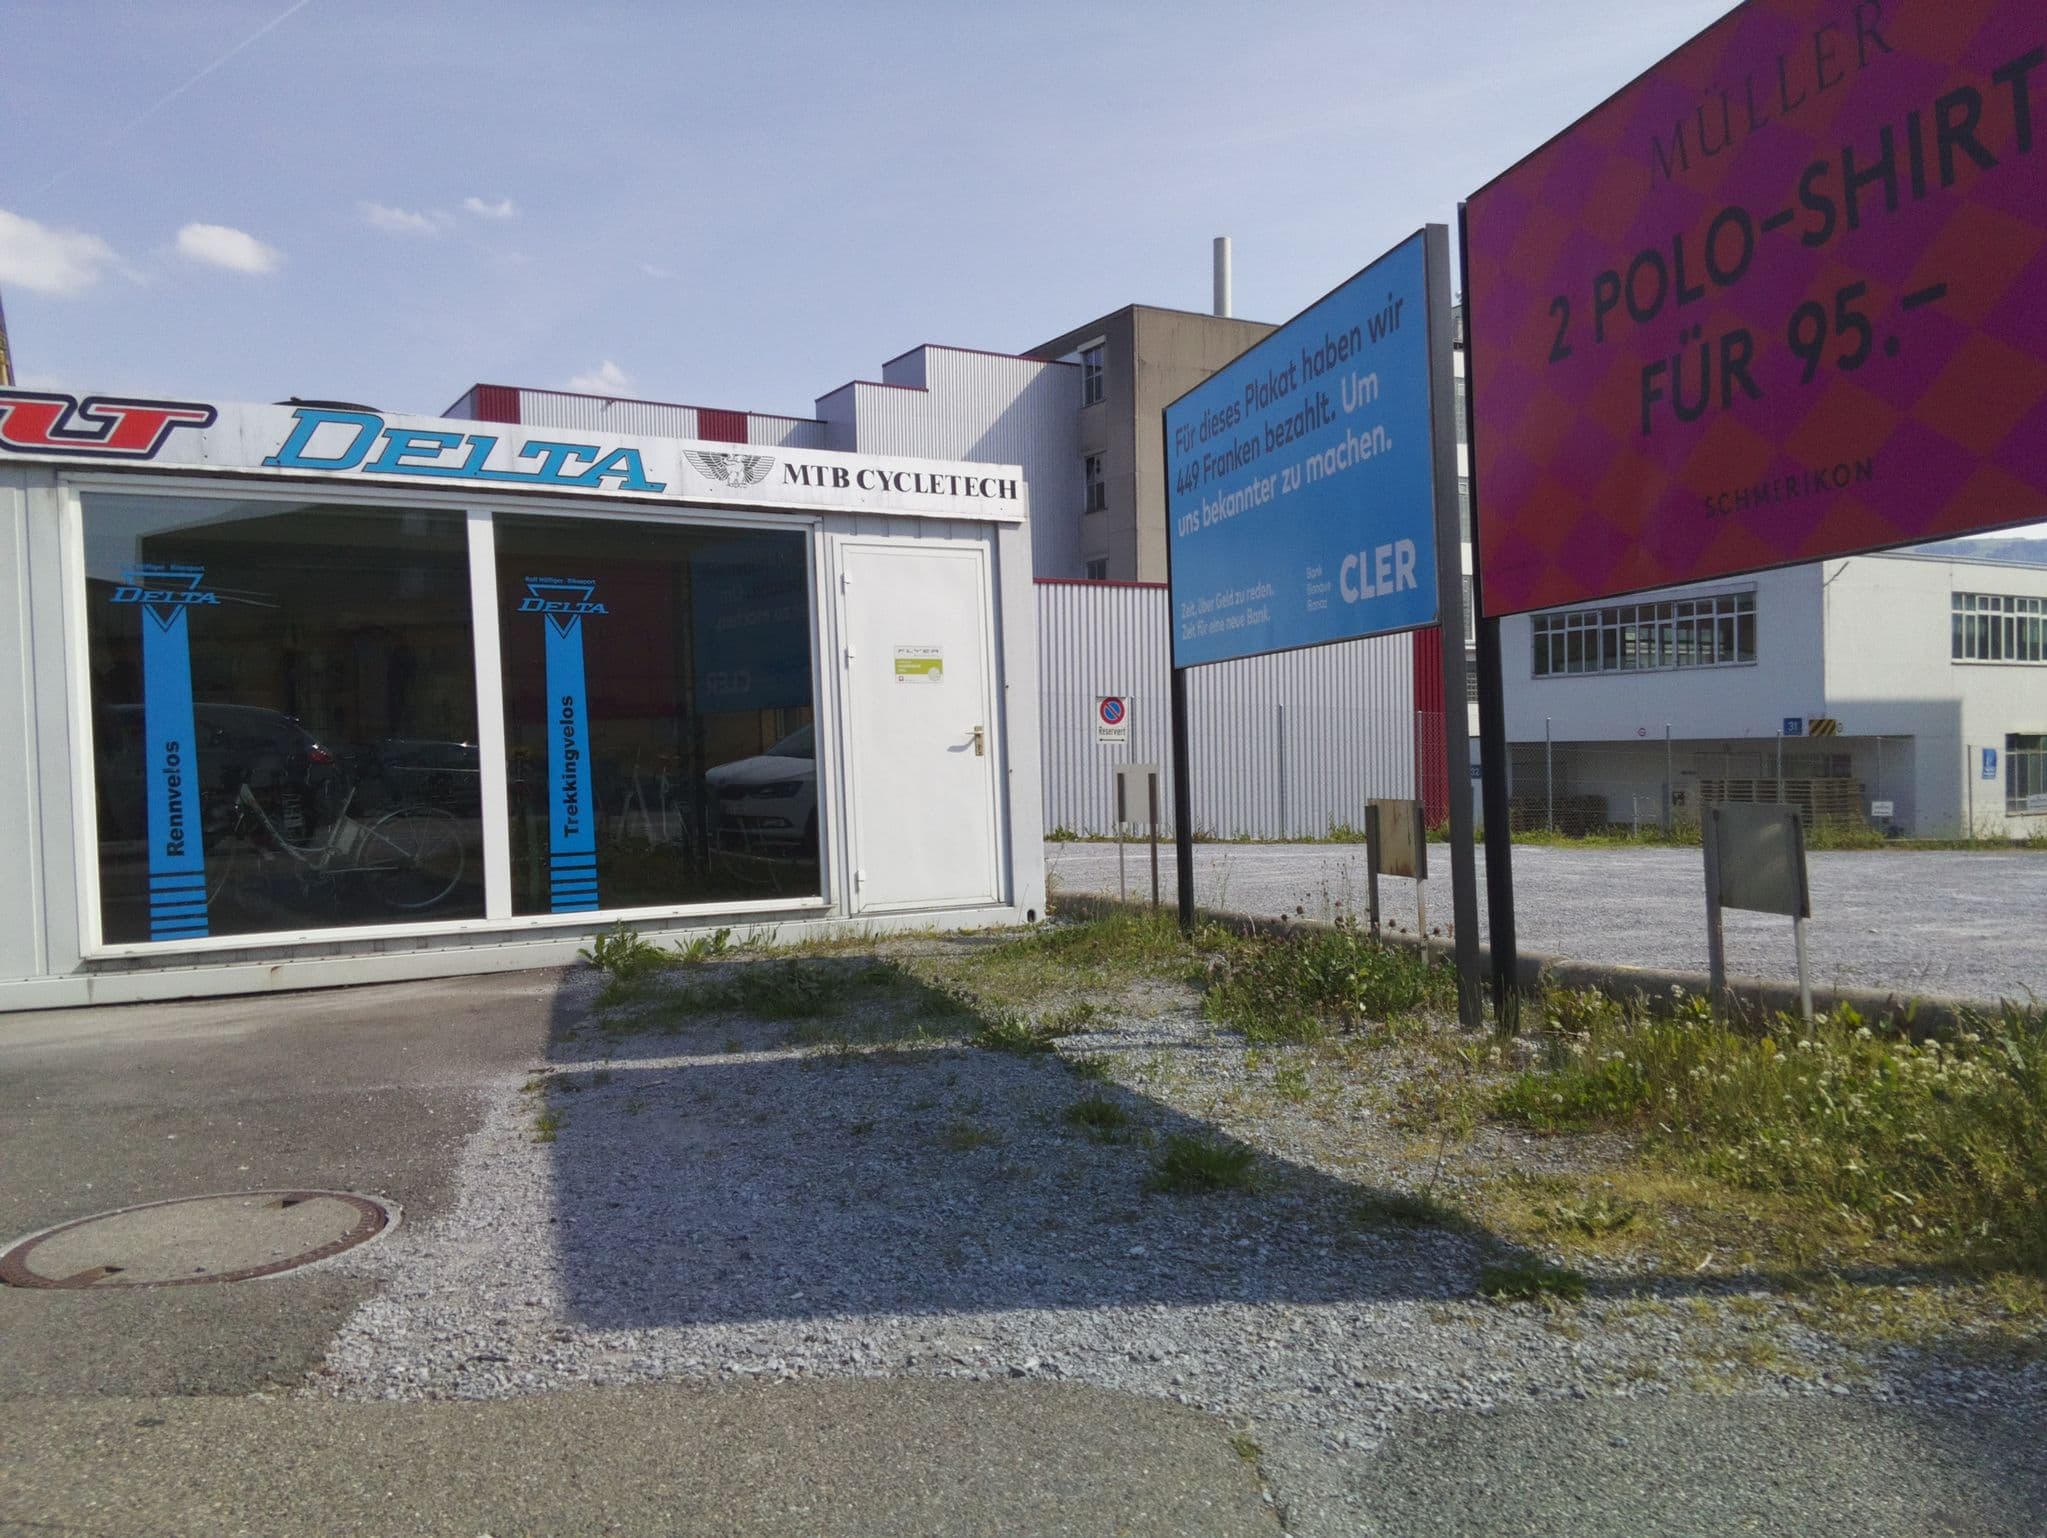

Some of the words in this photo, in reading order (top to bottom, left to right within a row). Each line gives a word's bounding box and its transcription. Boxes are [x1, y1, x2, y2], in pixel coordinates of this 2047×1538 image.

[1651, 0, 1895, 190] MÜLLER
[1547, 295, 1573, 366] 2
[1592, 42, 2046, 346] POLO-SHIRT
[1175, 423, 1197, 459] Für
[1200, 399, 1241, 444] dieses
[1244, 360, 1298, 417] Plakat
[1302, 333, 1362, 384] haben
[1367, 292, 1404, 343] wir
[1640, 324, 1766, 437] FÜR
[261, 408, 668, 493] DELTA
[782, 463, 851, 489] MTB
[857, 469, 1018, 500] CYCLETECH
[1176, 460, 1200, 496] 449
[1203, 435, 1261, 484] Franken
[1264, 390, 1337, 453] bezahlt.
[1341, 370, 1379, 414] Um
[1177, 509, 1200, 537] uns
[1202, 473, 1278, 529] bekannter
[1281, 463, 1301, 495] zu
[1306, 424, 1393, 484] machen.
[1703, 456, 1875, 520] SCHMERIKON
[517, 598, 610, 615] DELTA
[1340, 538, 1418, 604] CLER
[560, 695, 580, 838] Trekkingvelos
[1787, 720, 1798, 731] 31
[163, 740, 186, 857] Rennvelos
